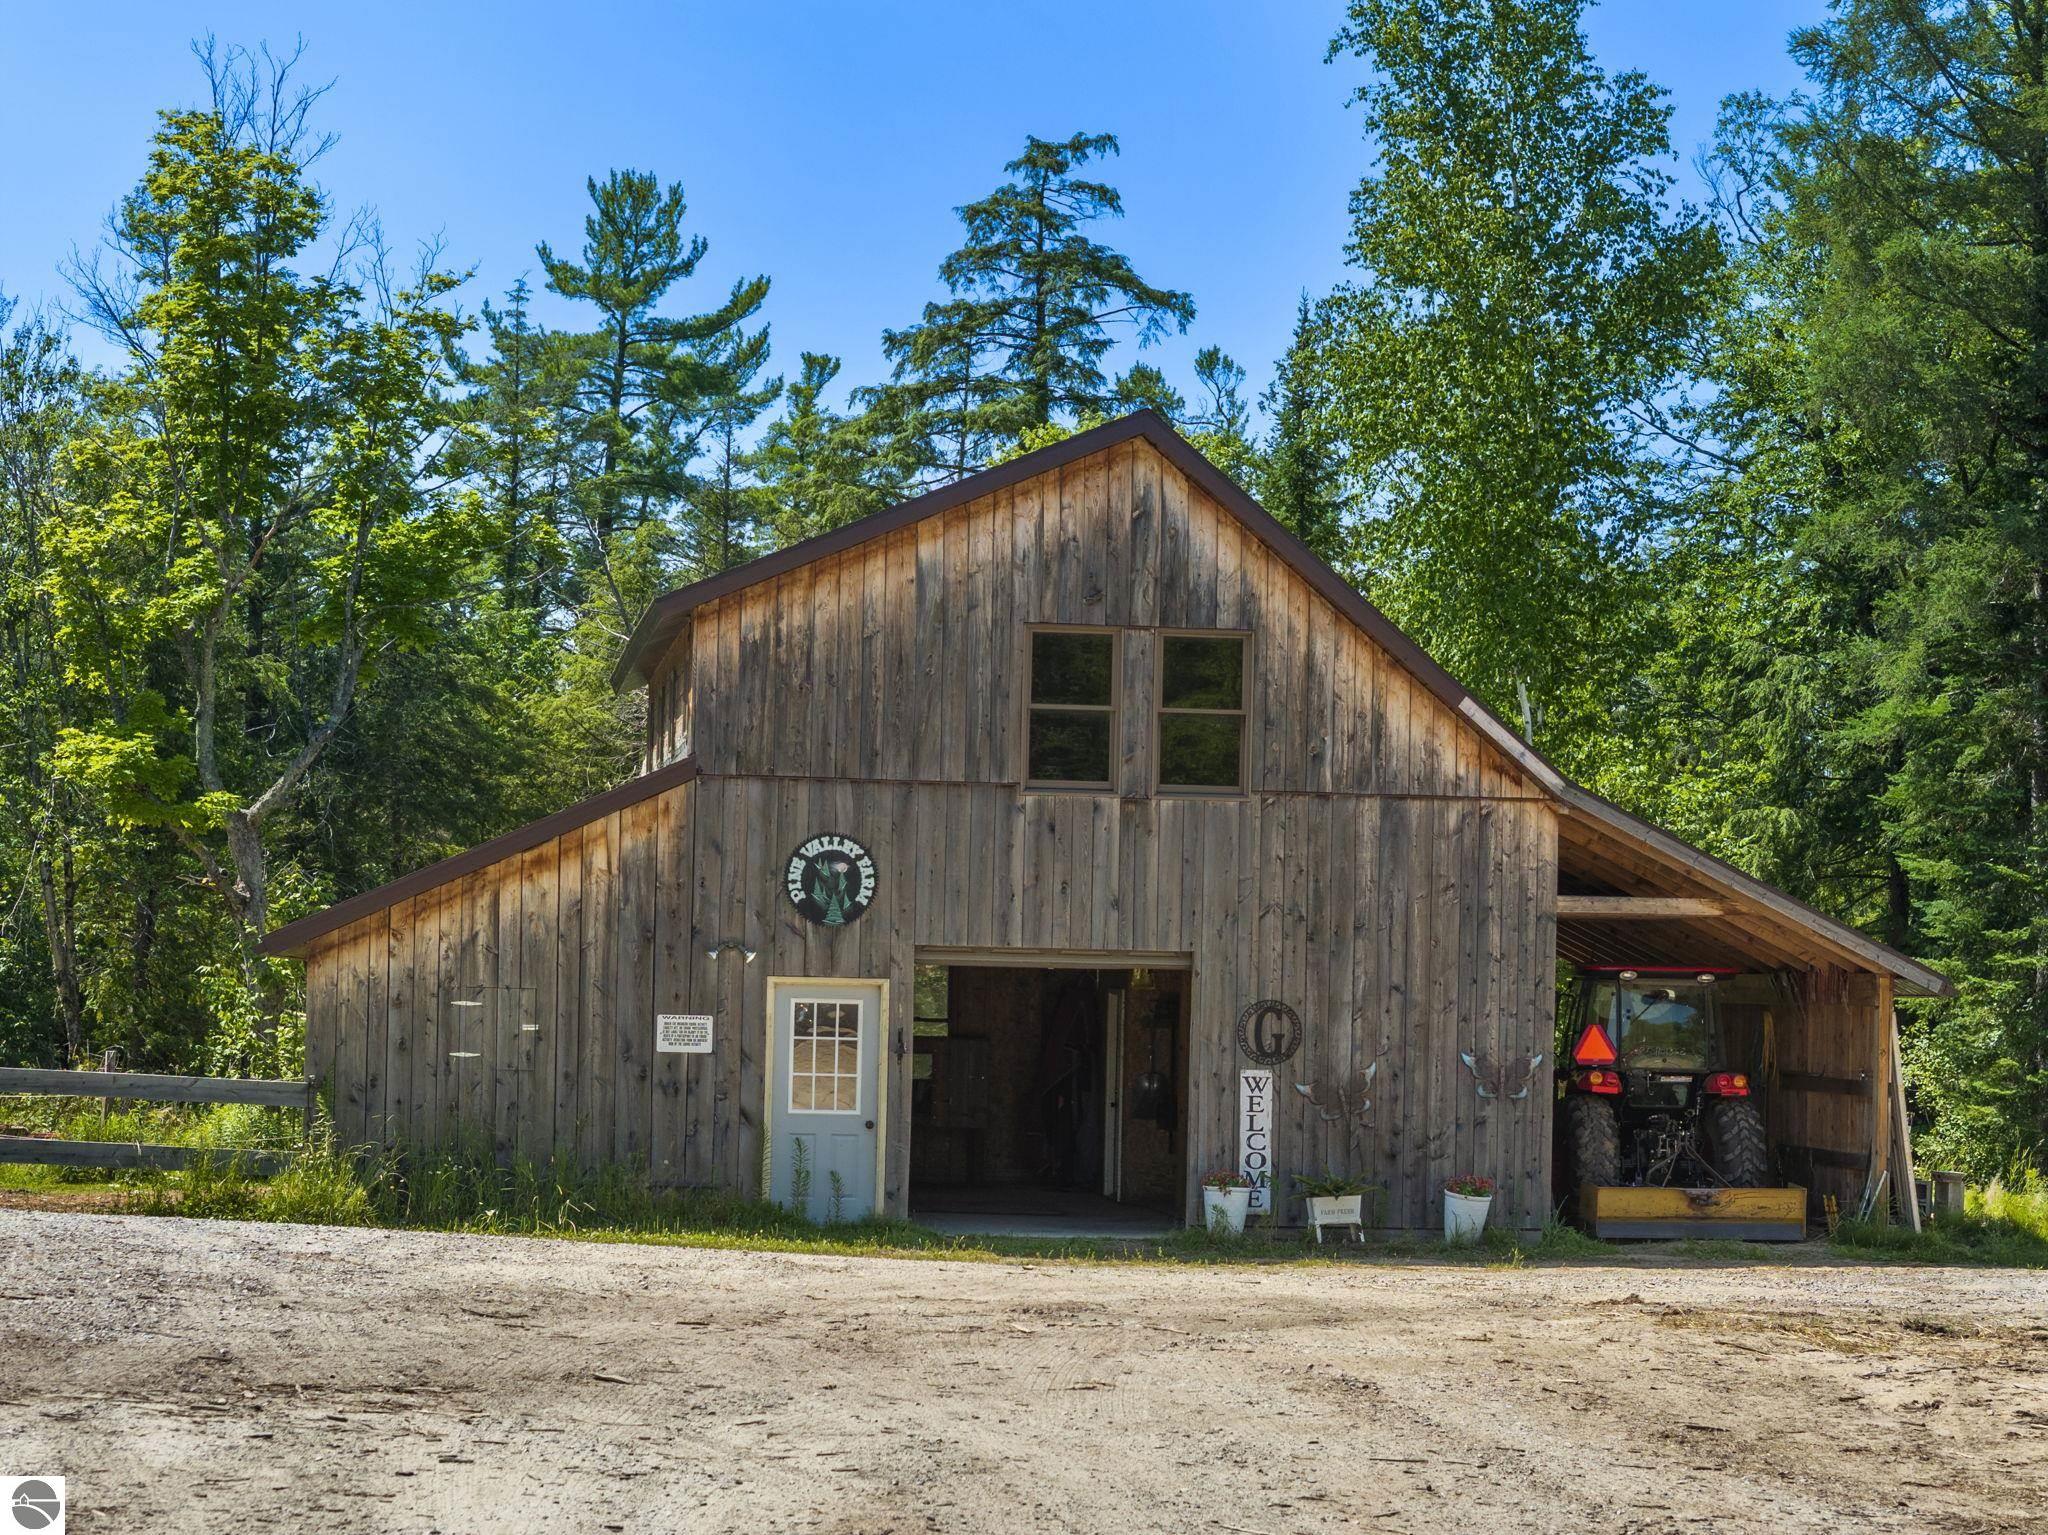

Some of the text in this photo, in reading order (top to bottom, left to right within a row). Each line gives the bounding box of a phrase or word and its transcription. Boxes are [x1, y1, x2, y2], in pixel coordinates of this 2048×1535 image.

[787, 836, 875, 906] PINE VALLEY FARM
[1254, 1007, 1285, 1059] G
[1242, 1075, 1271, 1209] WELCOME
